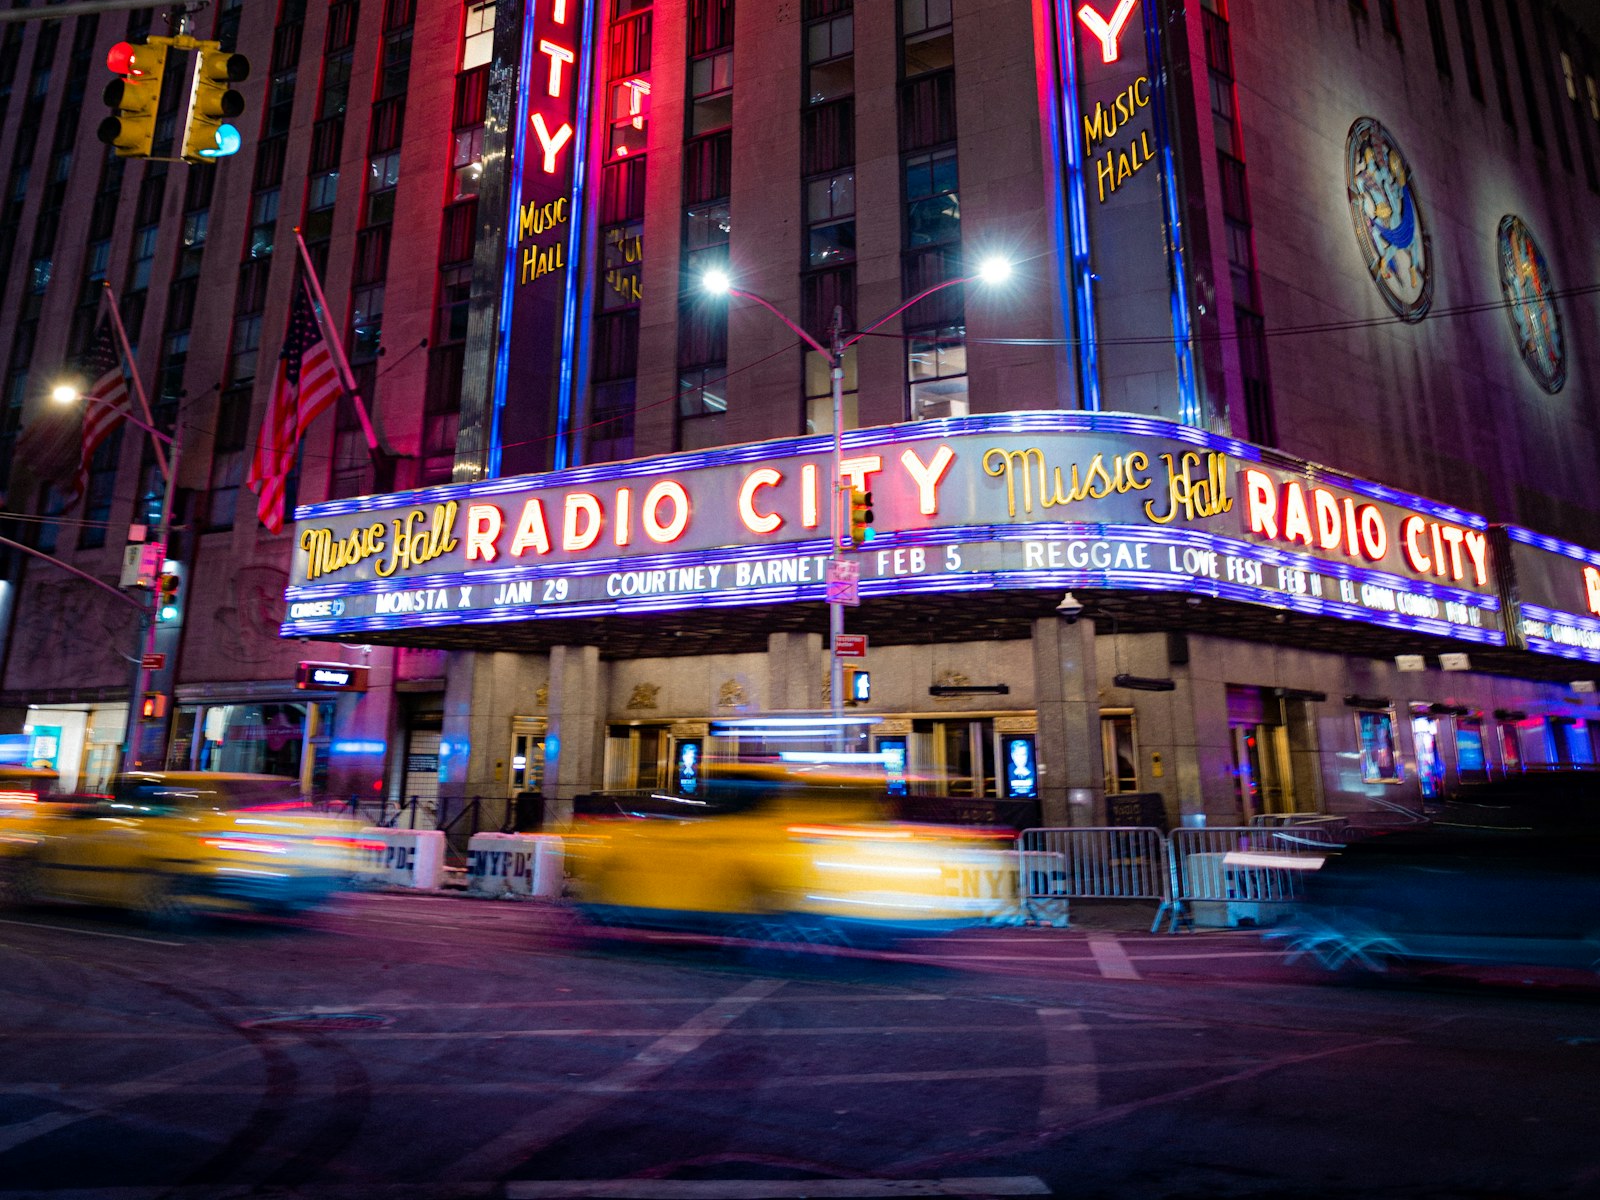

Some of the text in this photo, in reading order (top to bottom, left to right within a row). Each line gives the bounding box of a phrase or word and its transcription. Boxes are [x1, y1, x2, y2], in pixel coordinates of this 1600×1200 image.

[1084, 76, 1150, 157] MUSIC
[1096, 130, 1155, 203] HALL
[519, 196, 567, 242] MUSIC
[521, 242, 564, 285] HALL
[465, 443, 956, 562] RADIO CITY
[982, 447, 1234, 524] Music Hall
[300, 499, 461, 581] Music Hall
[1244, 469, 1488, 586] RADIO CITY
[375, 588, 448, 614] MONSTA
[458, 586, 472, 608] X
[494, 581, 532, 606] JAN
[543, 578, 569, 601] 29
[606, 565, 722, 597] COURTNEY
[736, 555, 835, 587] BARNET
[877, 549, 926, 577] FEB
[945, 544, 962, 571] 5
[1025, 541, 1150, 570] REGGAE
[1169, 544, 1218, 581] LOVE
[1226, 555, 1263, 587] FEST
[1277, 566, 1307, 595] FEB
[476, 850, 527, 877] NYPD
